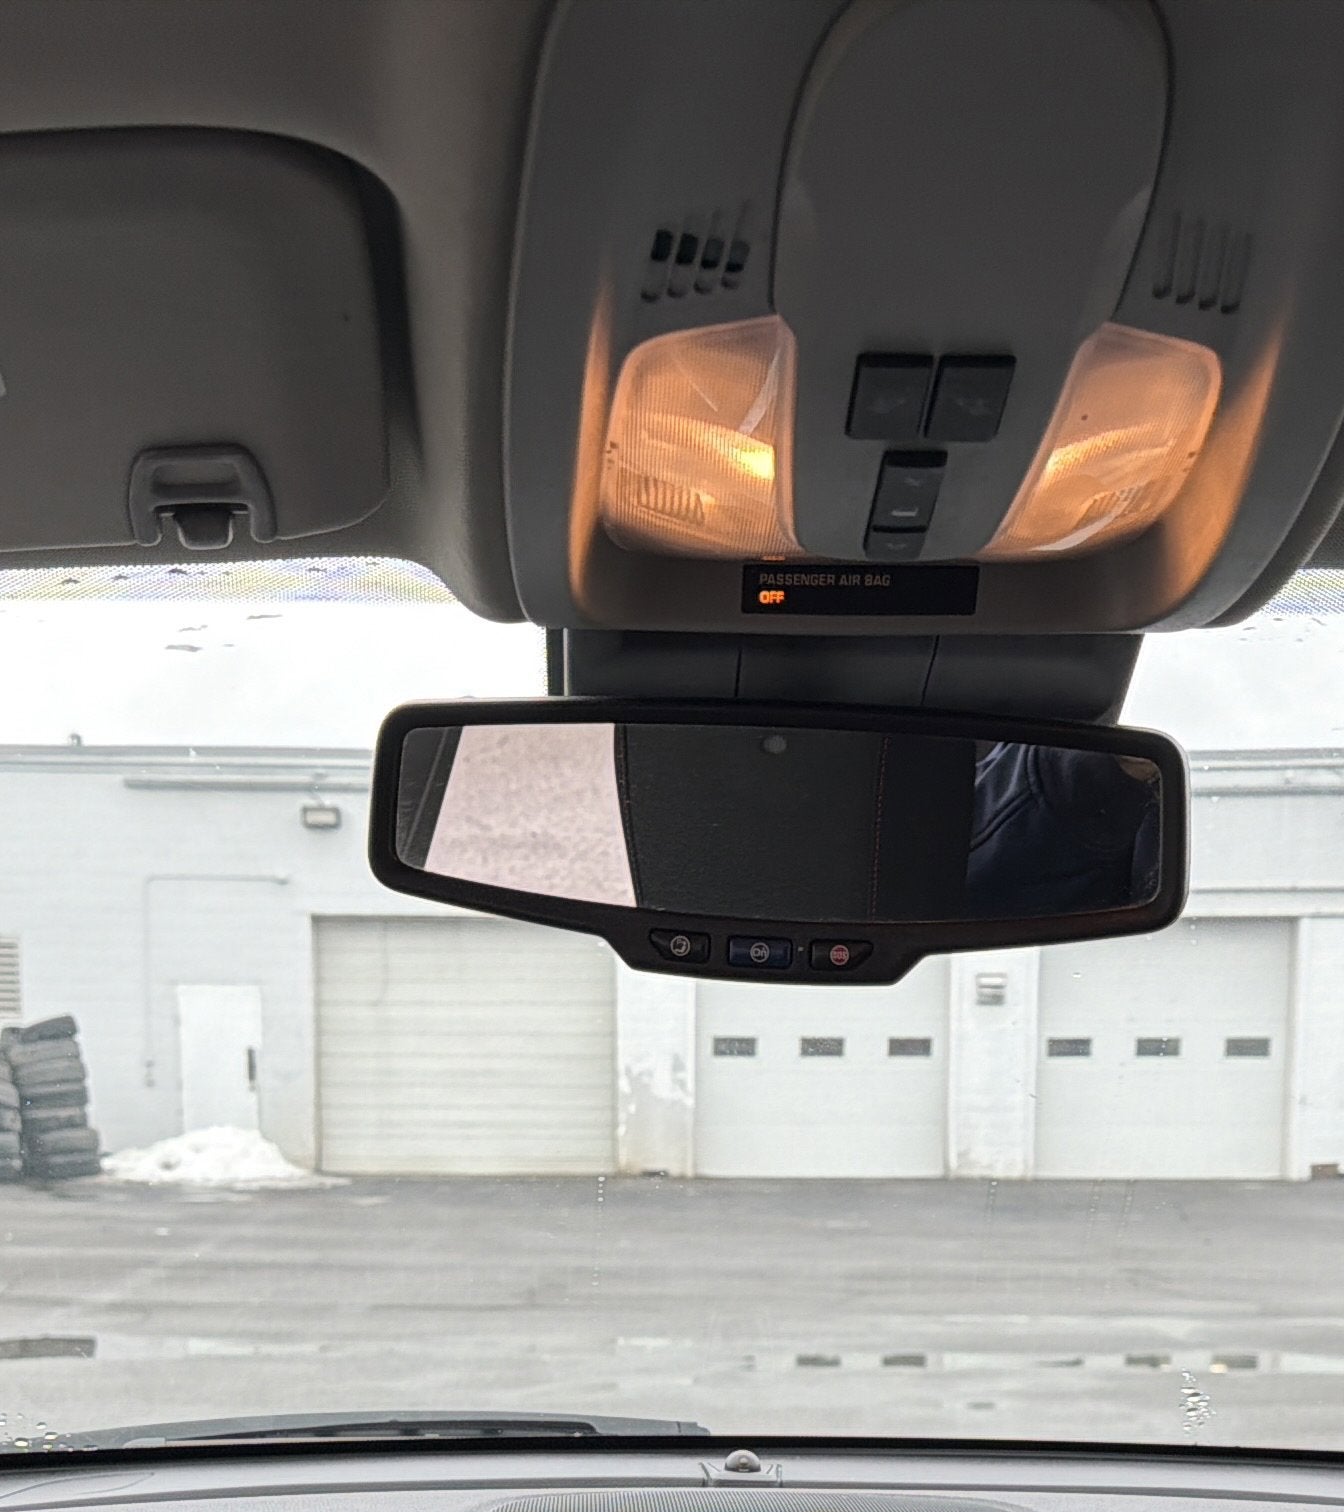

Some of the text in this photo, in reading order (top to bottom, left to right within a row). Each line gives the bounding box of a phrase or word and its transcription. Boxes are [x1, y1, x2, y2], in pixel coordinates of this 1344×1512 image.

[759, 573, 891, 587] PASSENGER AIR BAG
[758, 590, 785, 604] OFF
